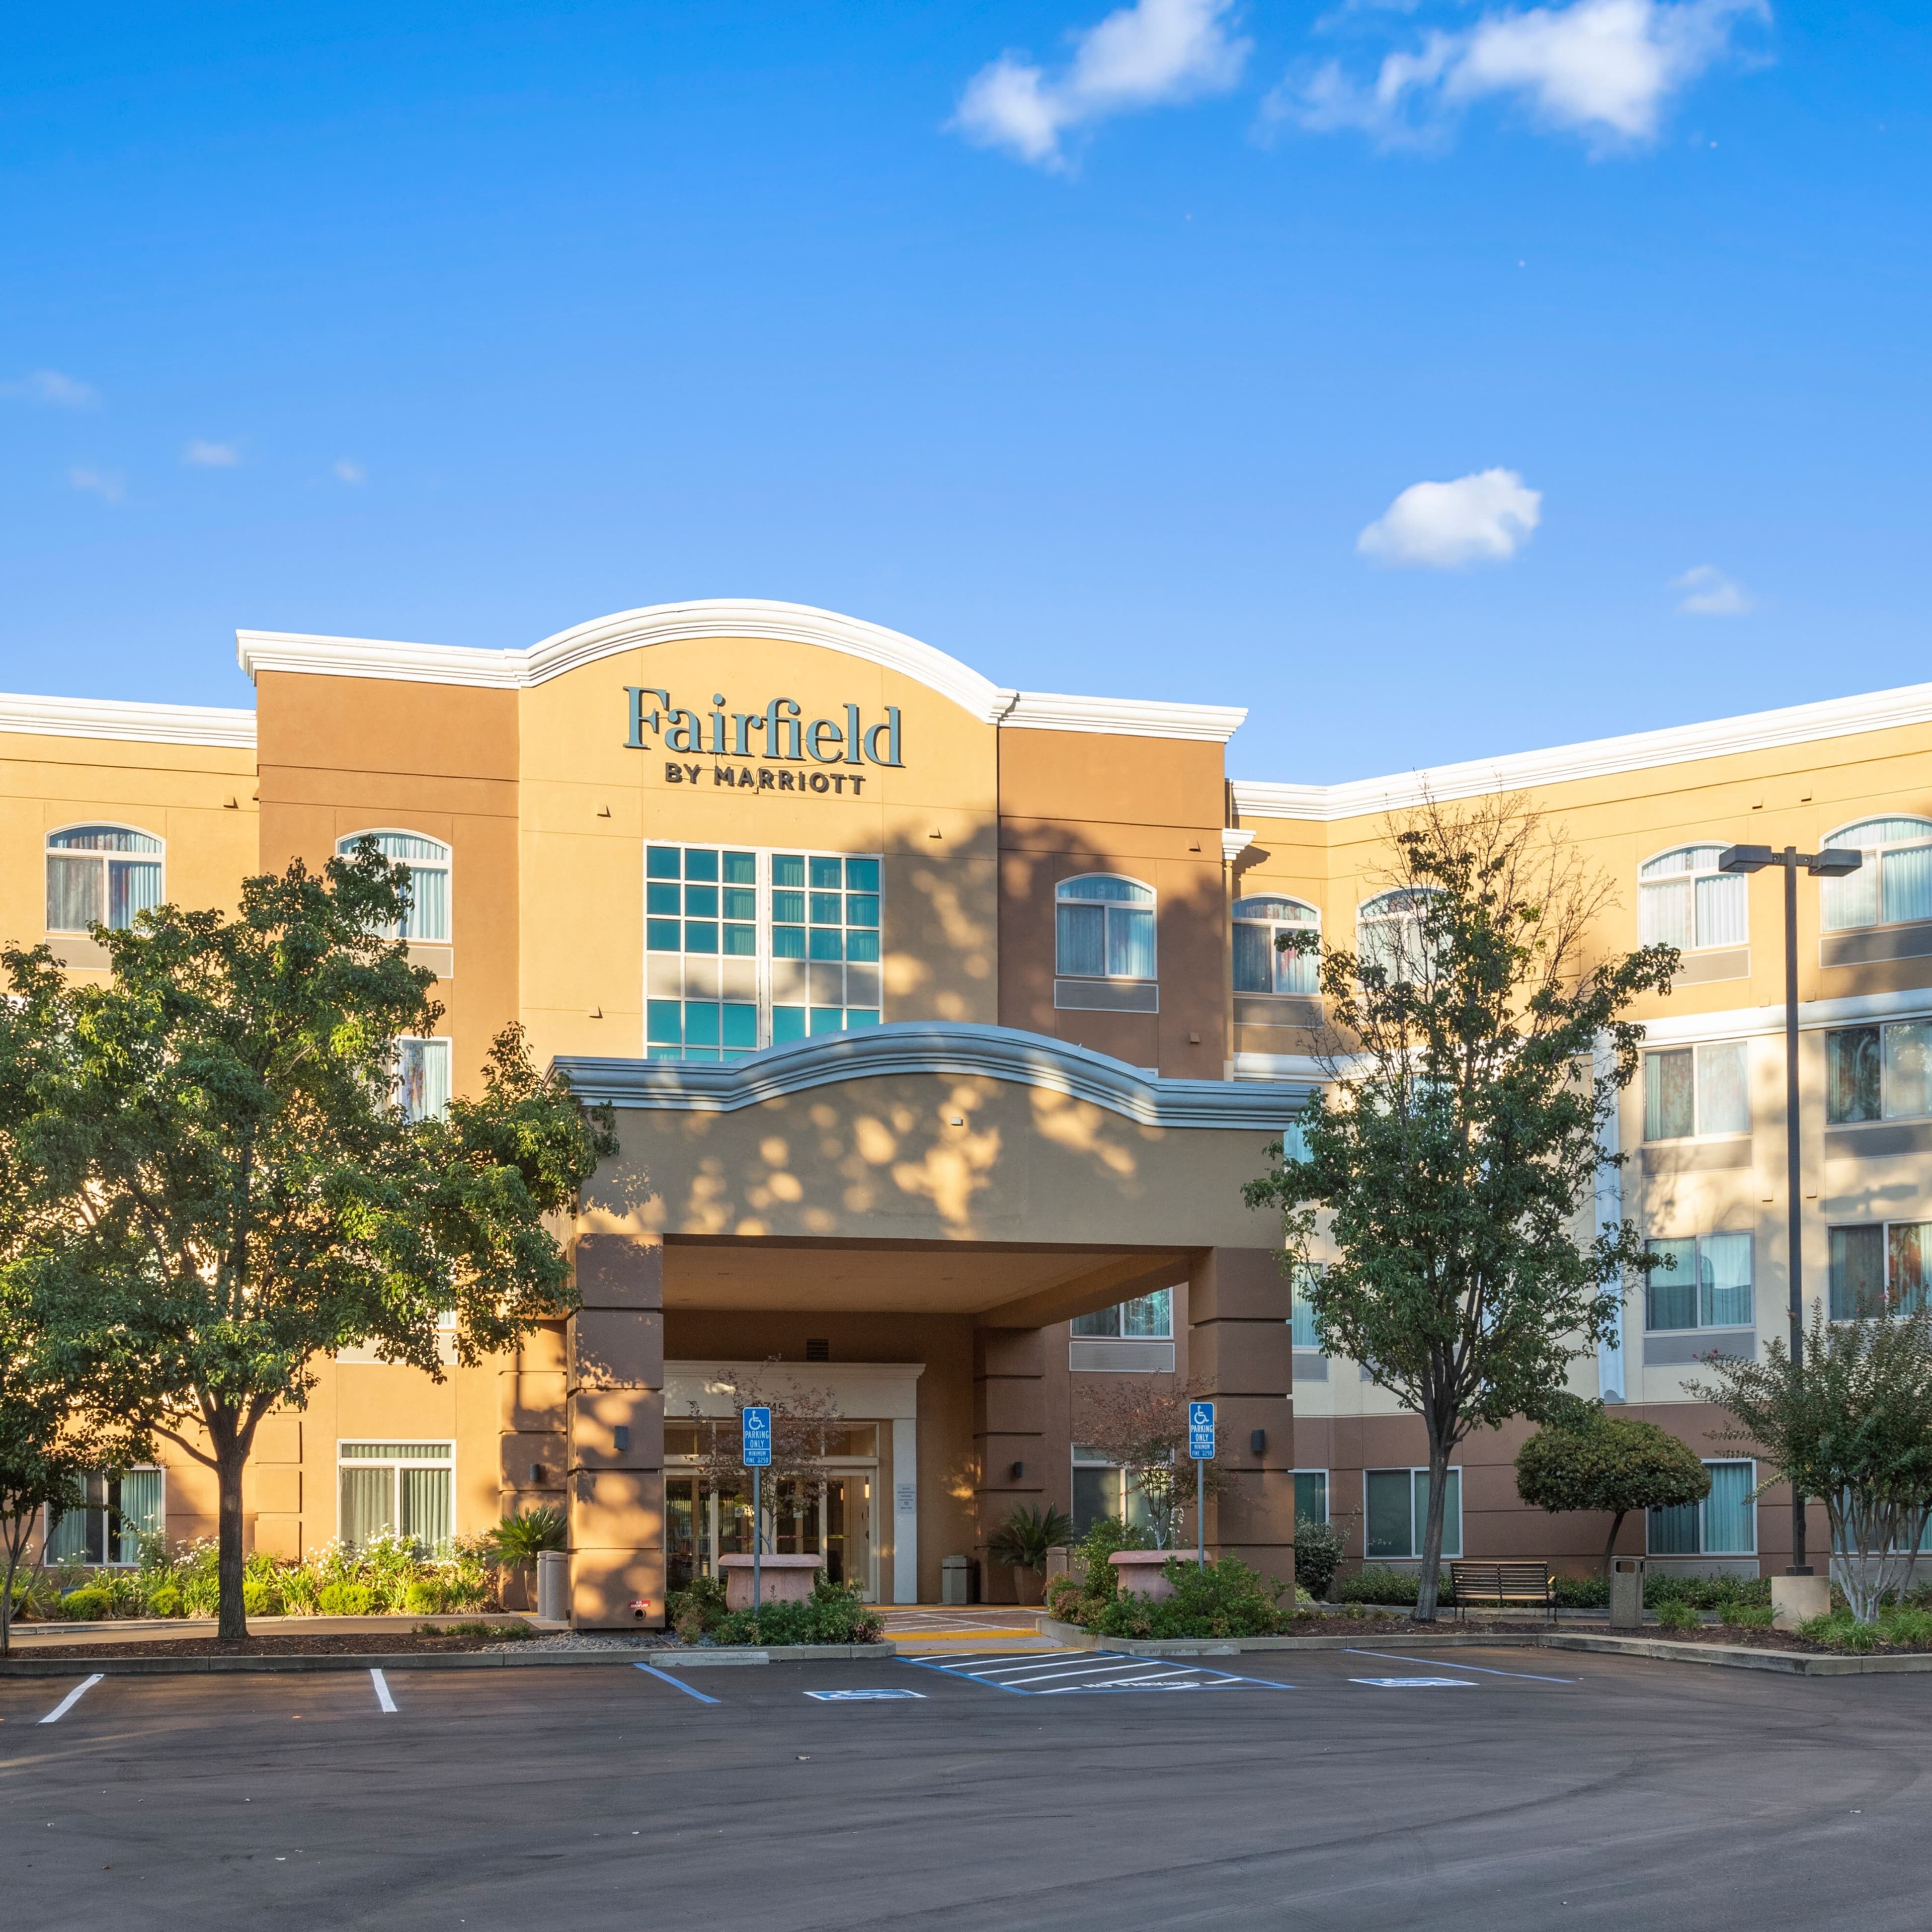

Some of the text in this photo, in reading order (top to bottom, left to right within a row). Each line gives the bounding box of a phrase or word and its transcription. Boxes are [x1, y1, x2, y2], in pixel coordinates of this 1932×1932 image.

[623, 686, 905, 767] Fairfield
[665, 762, 865, 794] BY MARRIOTT
[1191, 1425, 1213, 1433] PARKING
[745, 1430, 769, 1439] PARKING
[1195, 1433, 1209, 1441] ONLY
[750, 1440, 765, 1448] ONLY
